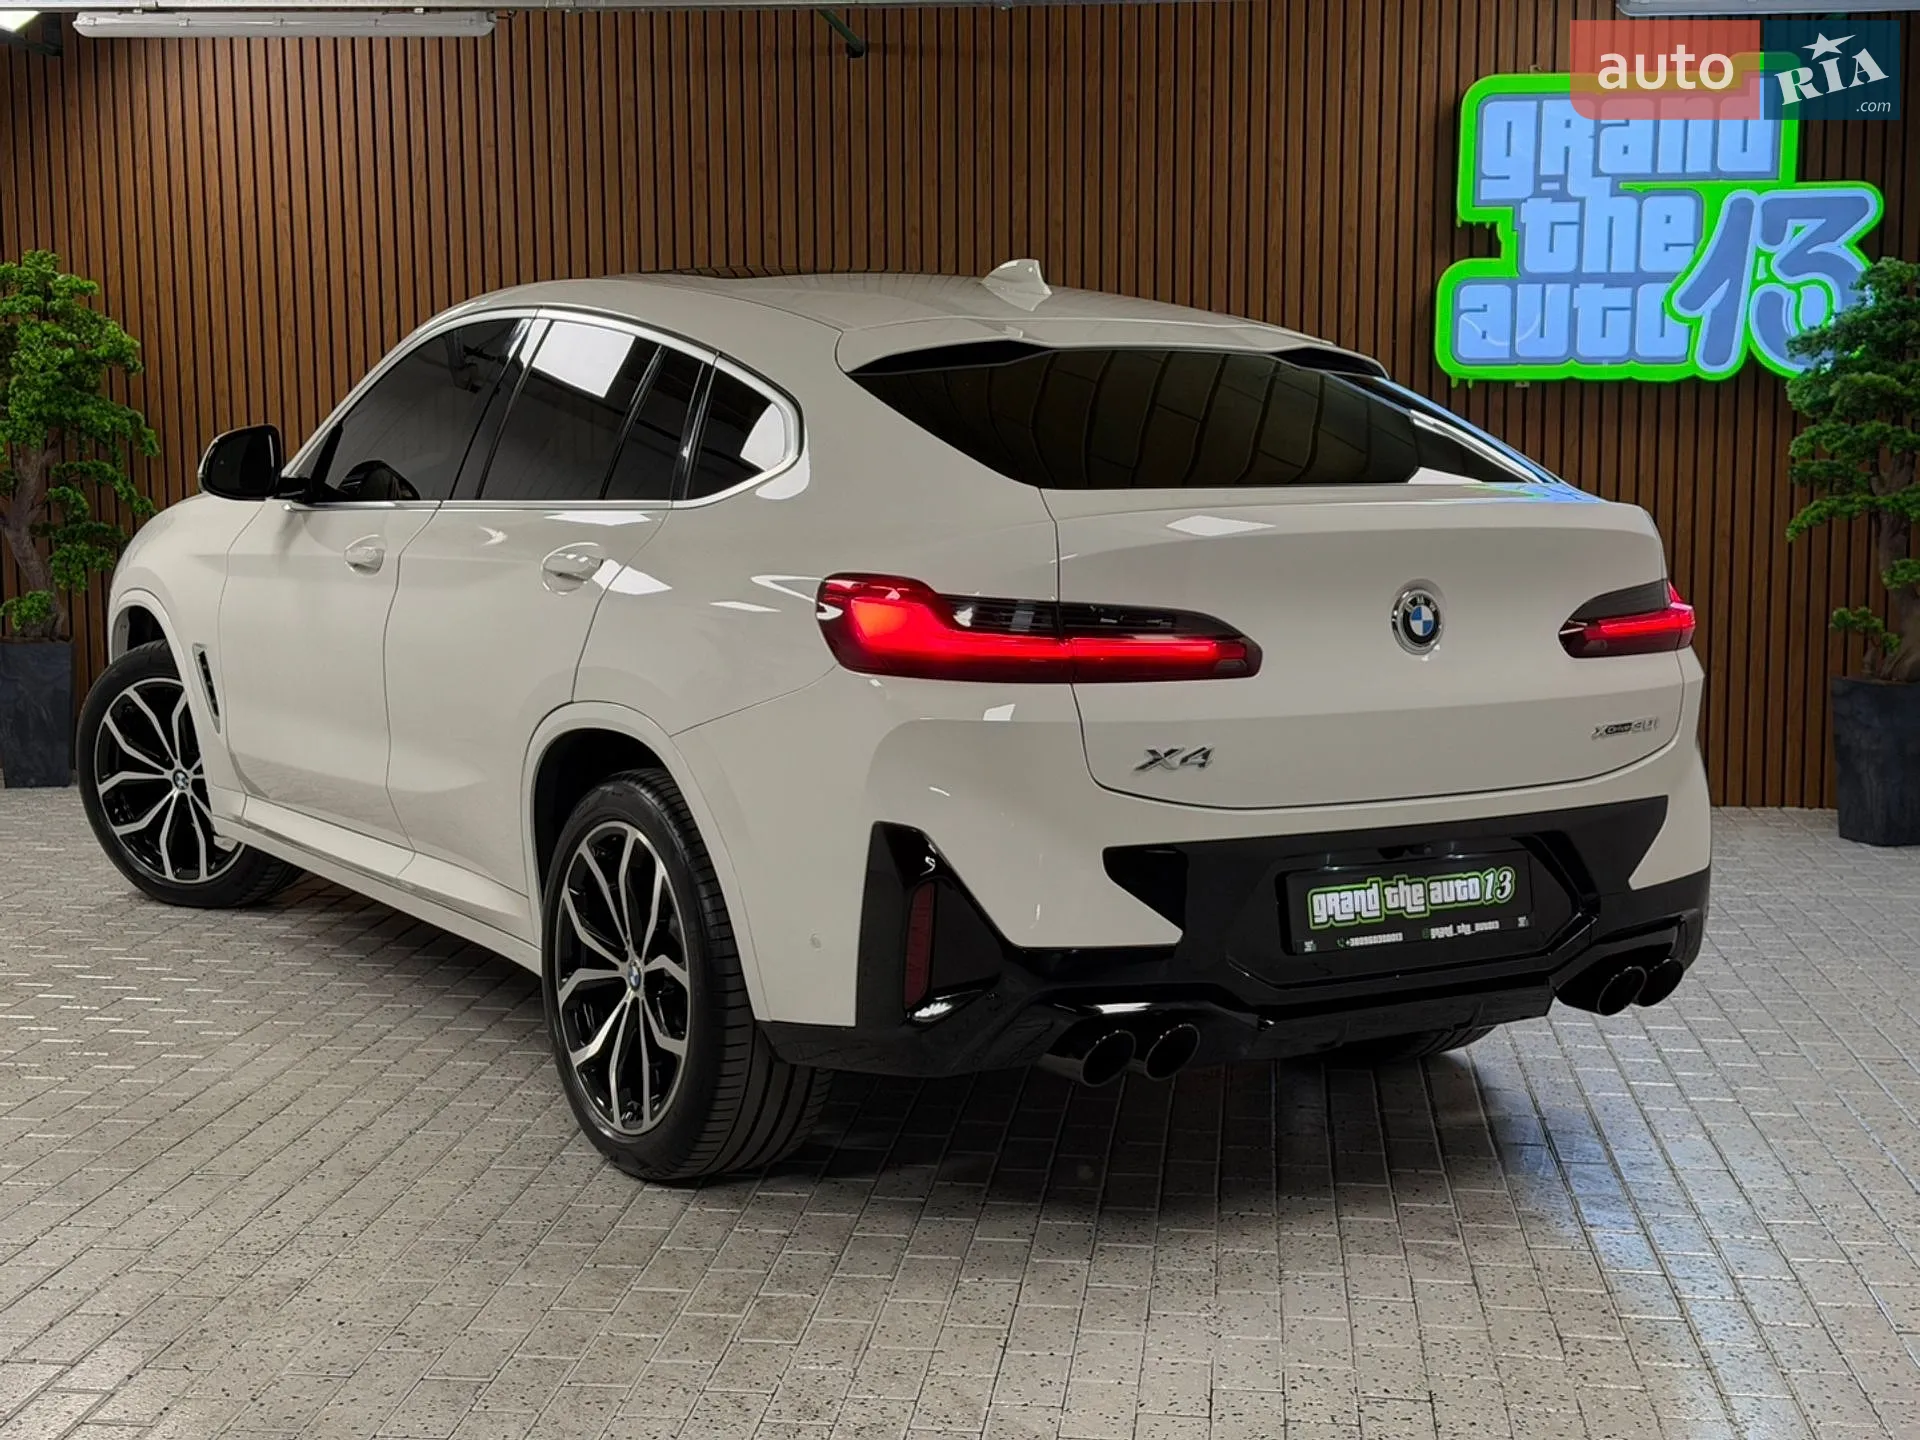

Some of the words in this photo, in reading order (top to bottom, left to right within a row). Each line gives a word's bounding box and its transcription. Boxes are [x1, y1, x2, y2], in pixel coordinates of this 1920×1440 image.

[1520, 178, 1697, 274] the
[1457, 283, 1691, 360] auto
[1671, 189, 1878, 374] 13
[1133, 745, 1215, 772] X4
[1384, 880, 1426, 913] the
